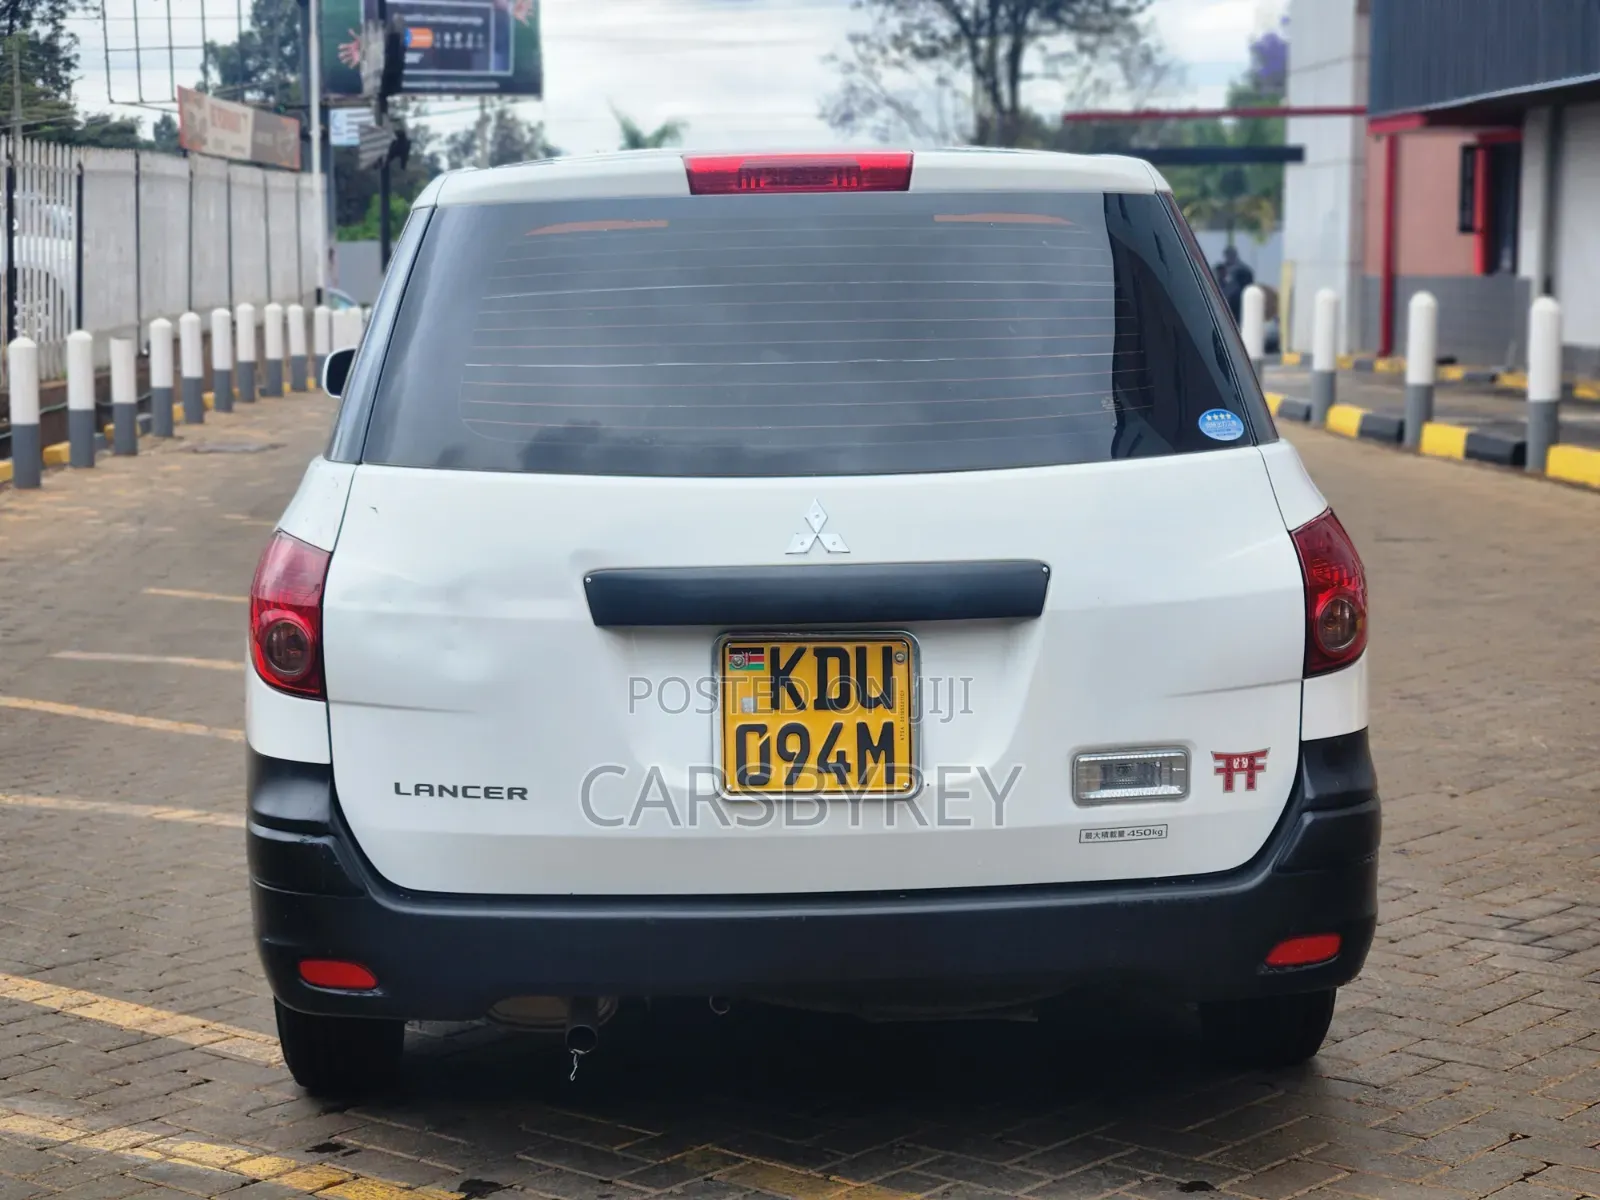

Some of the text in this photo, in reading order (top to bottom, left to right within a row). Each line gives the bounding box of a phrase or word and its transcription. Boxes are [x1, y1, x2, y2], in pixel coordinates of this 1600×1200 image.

[769, 646, 893, 711] KDU
[735, 721, 895, 786] 094M
[394, 782, 529, 801] LANCER
[1127, 828, 1163, 837] 450kg
